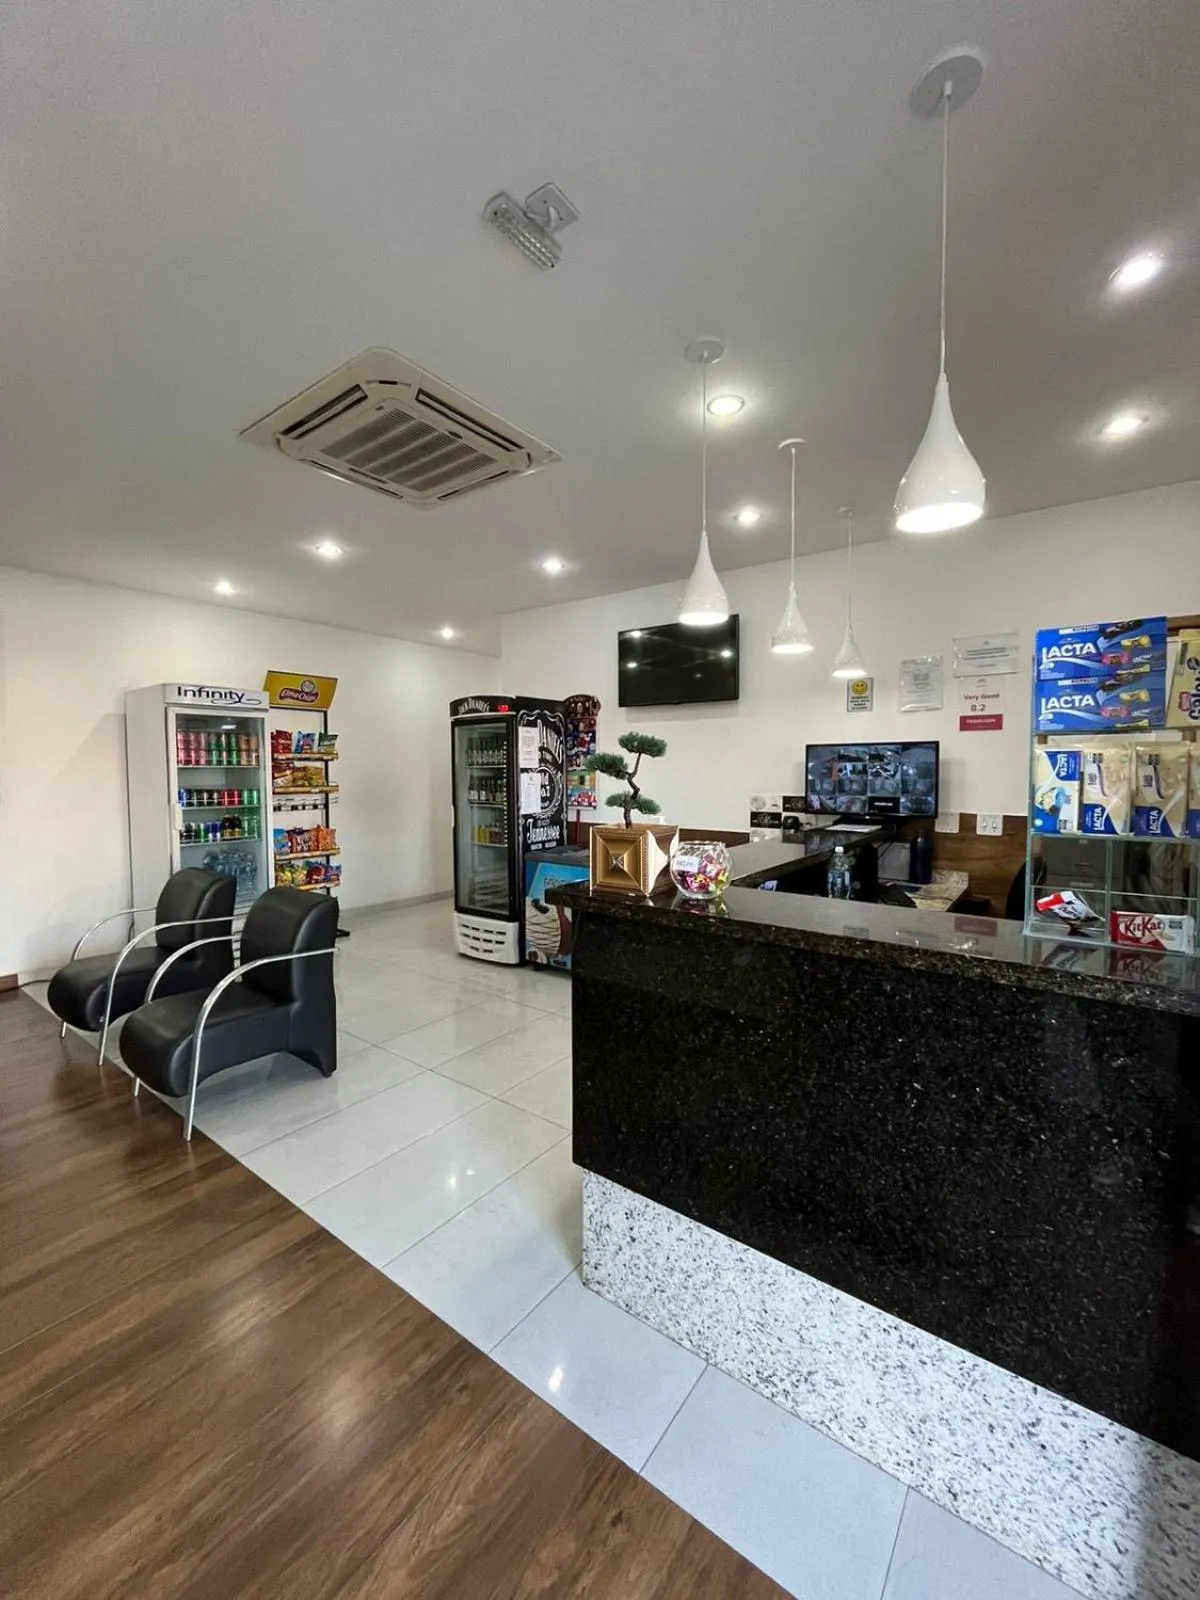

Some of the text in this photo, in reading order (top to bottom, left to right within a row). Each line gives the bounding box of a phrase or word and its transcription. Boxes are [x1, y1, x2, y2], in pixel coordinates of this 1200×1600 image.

[1042, 642, 1096, 662] LACTA
[177, 686, 246, 704] Infinity
[963, 692, 1000, 701] Very Good
[1041, 694, 1095, 714] LACTA
[1057, 754, 1068, 778] LACTA
[1093, 807, 1105, 831] LACTA
[1149, 810, 1161, 834] LACTA
[1125, 915, 1163, 937] KitKat
